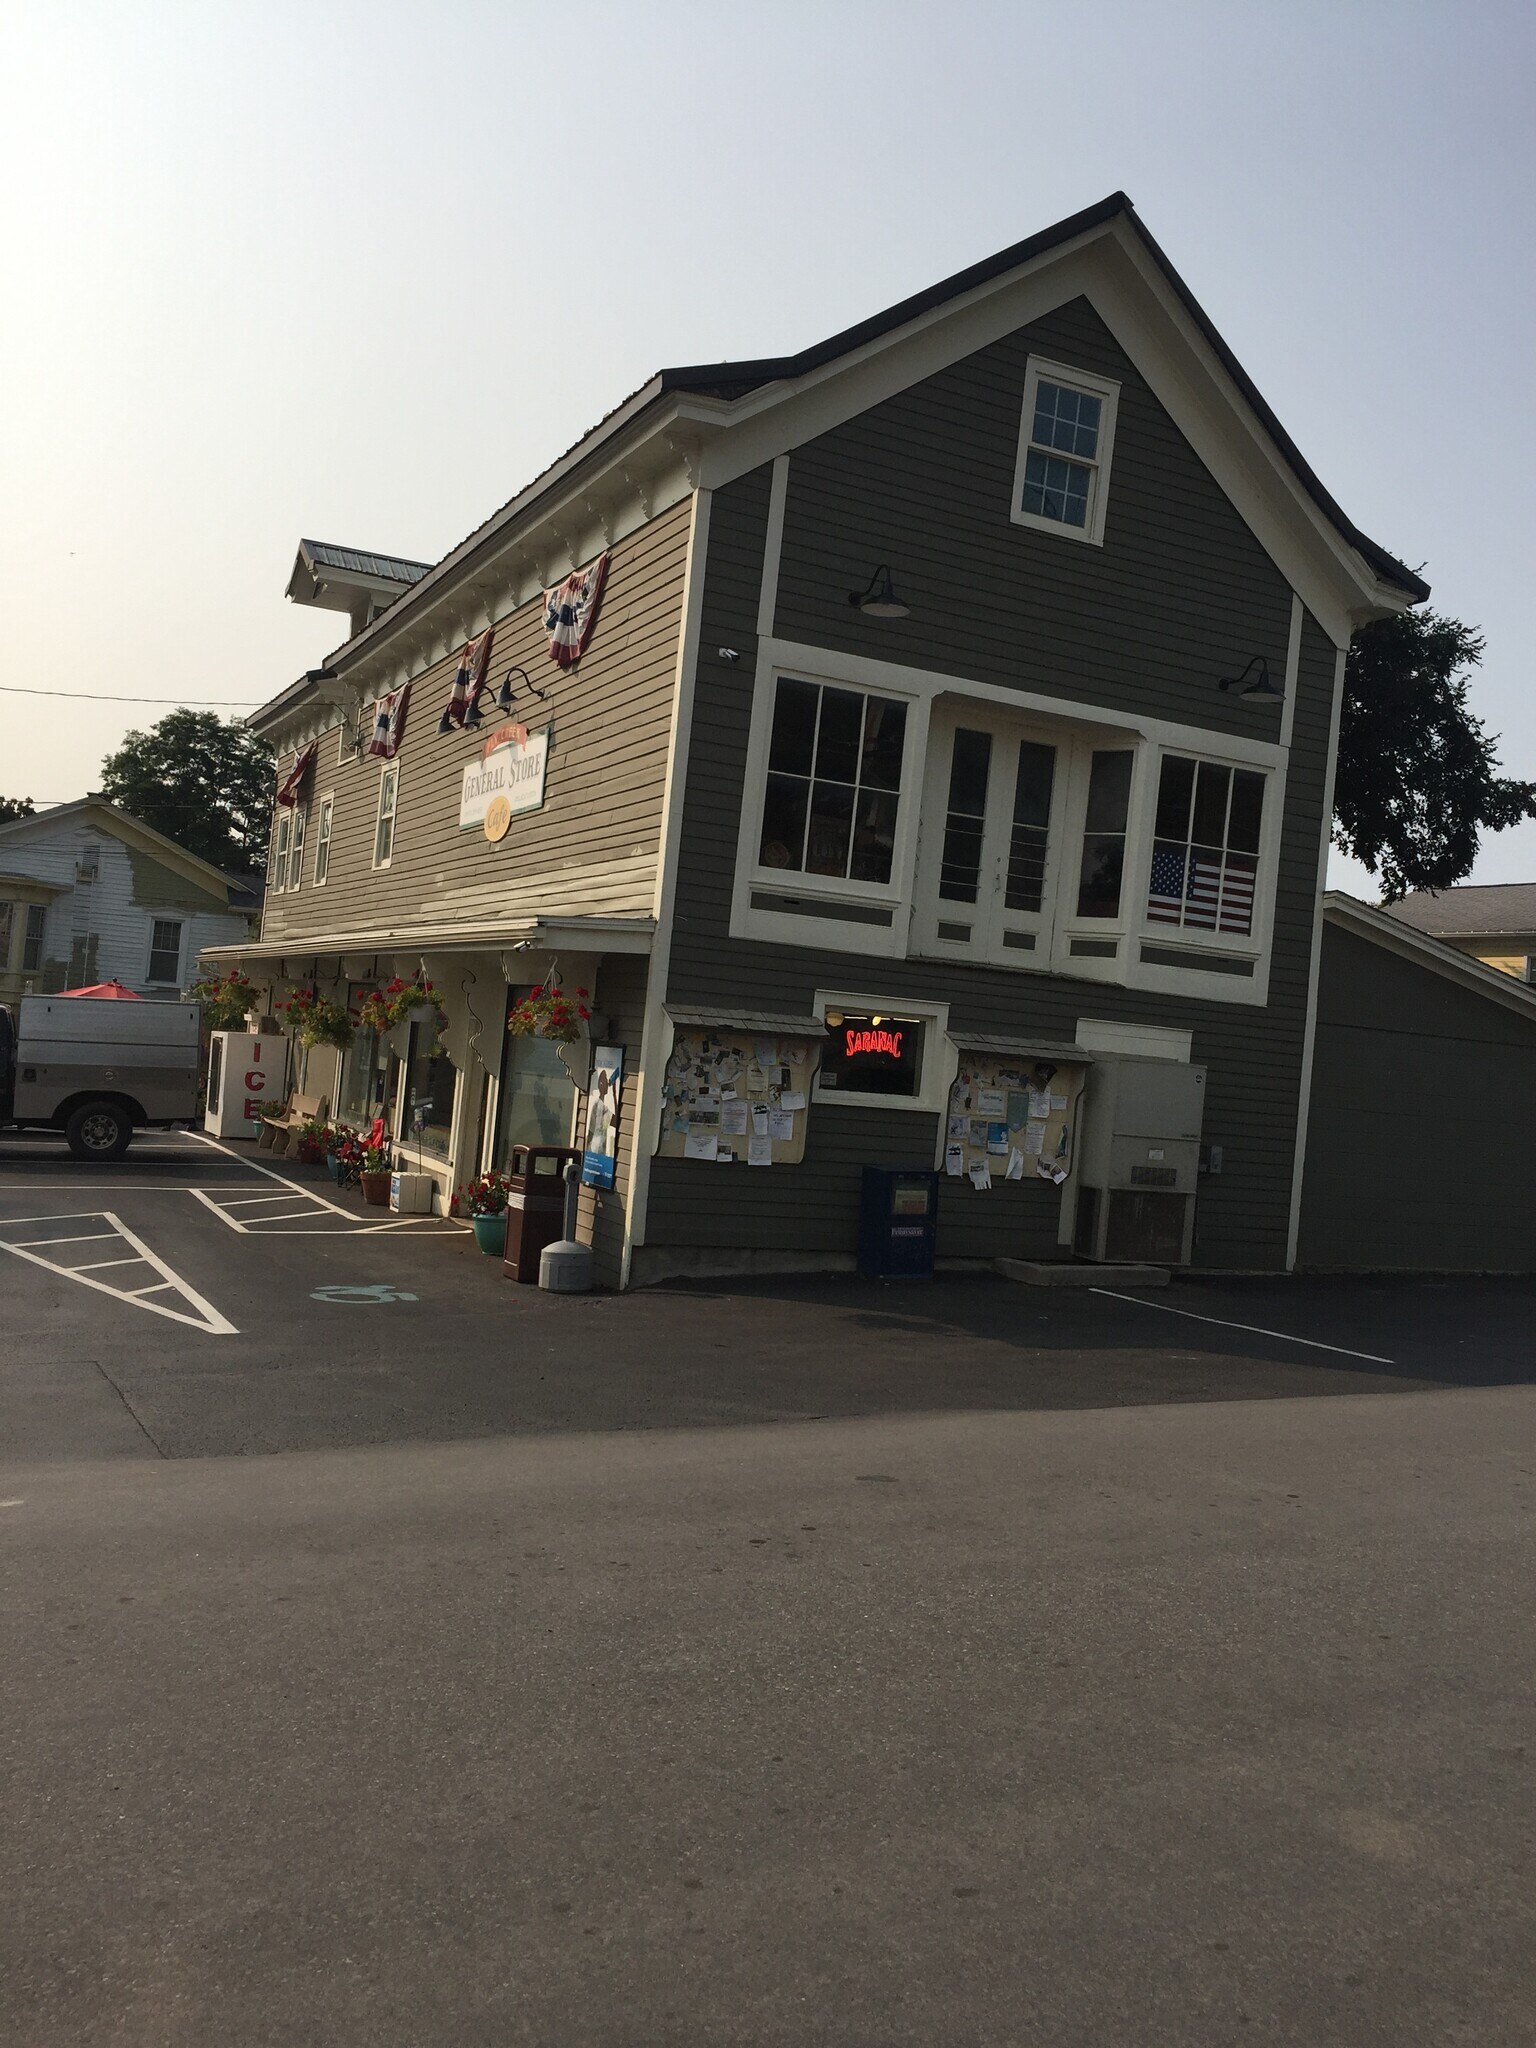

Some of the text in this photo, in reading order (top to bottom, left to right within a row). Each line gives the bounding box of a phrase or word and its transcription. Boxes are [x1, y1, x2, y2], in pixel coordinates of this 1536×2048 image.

[465, 753, 541, 802] GENERAL STORE
[846, 1030, 903, 1058] SARANAC
[245, 1043, 265, 1119] ICE
